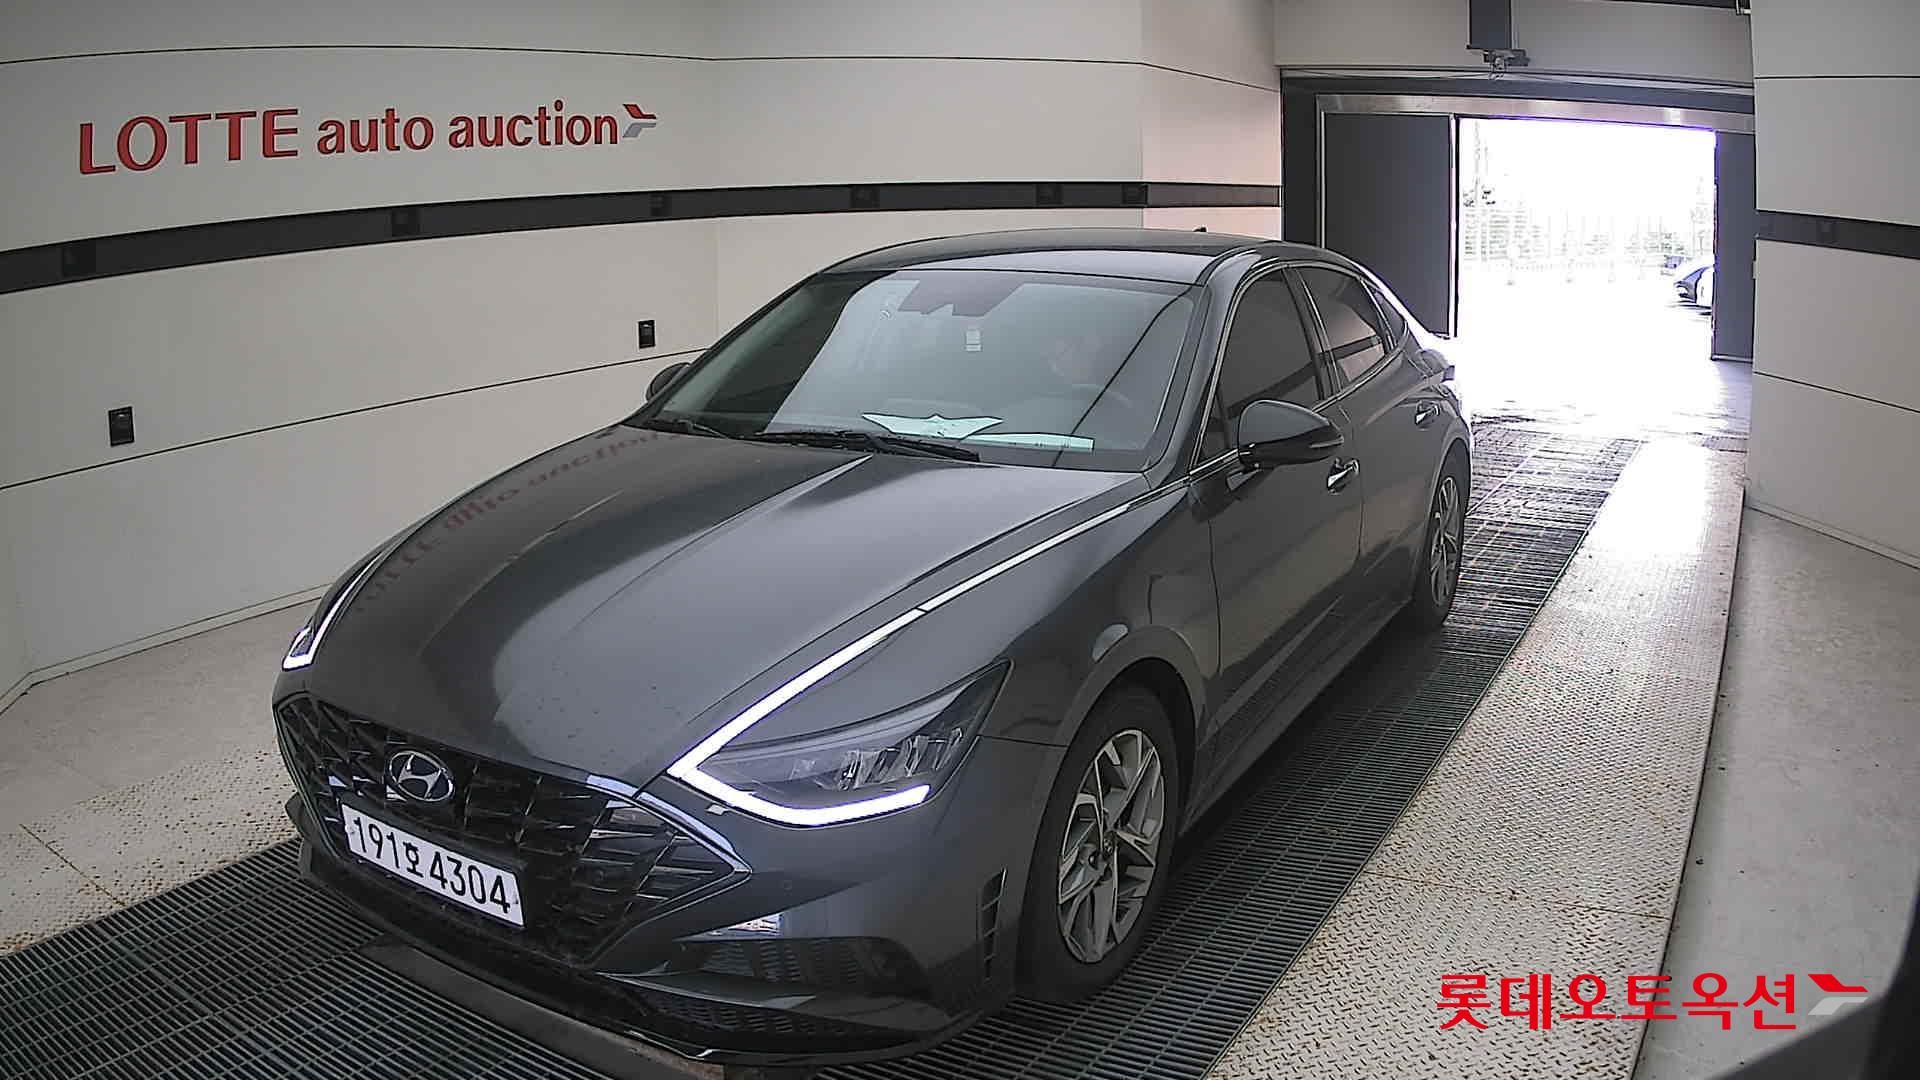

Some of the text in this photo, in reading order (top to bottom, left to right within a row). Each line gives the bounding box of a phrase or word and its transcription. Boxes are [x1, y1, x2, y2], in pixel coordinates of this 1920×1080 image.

[80, 100, 620, 175] LOTTE auto auction
